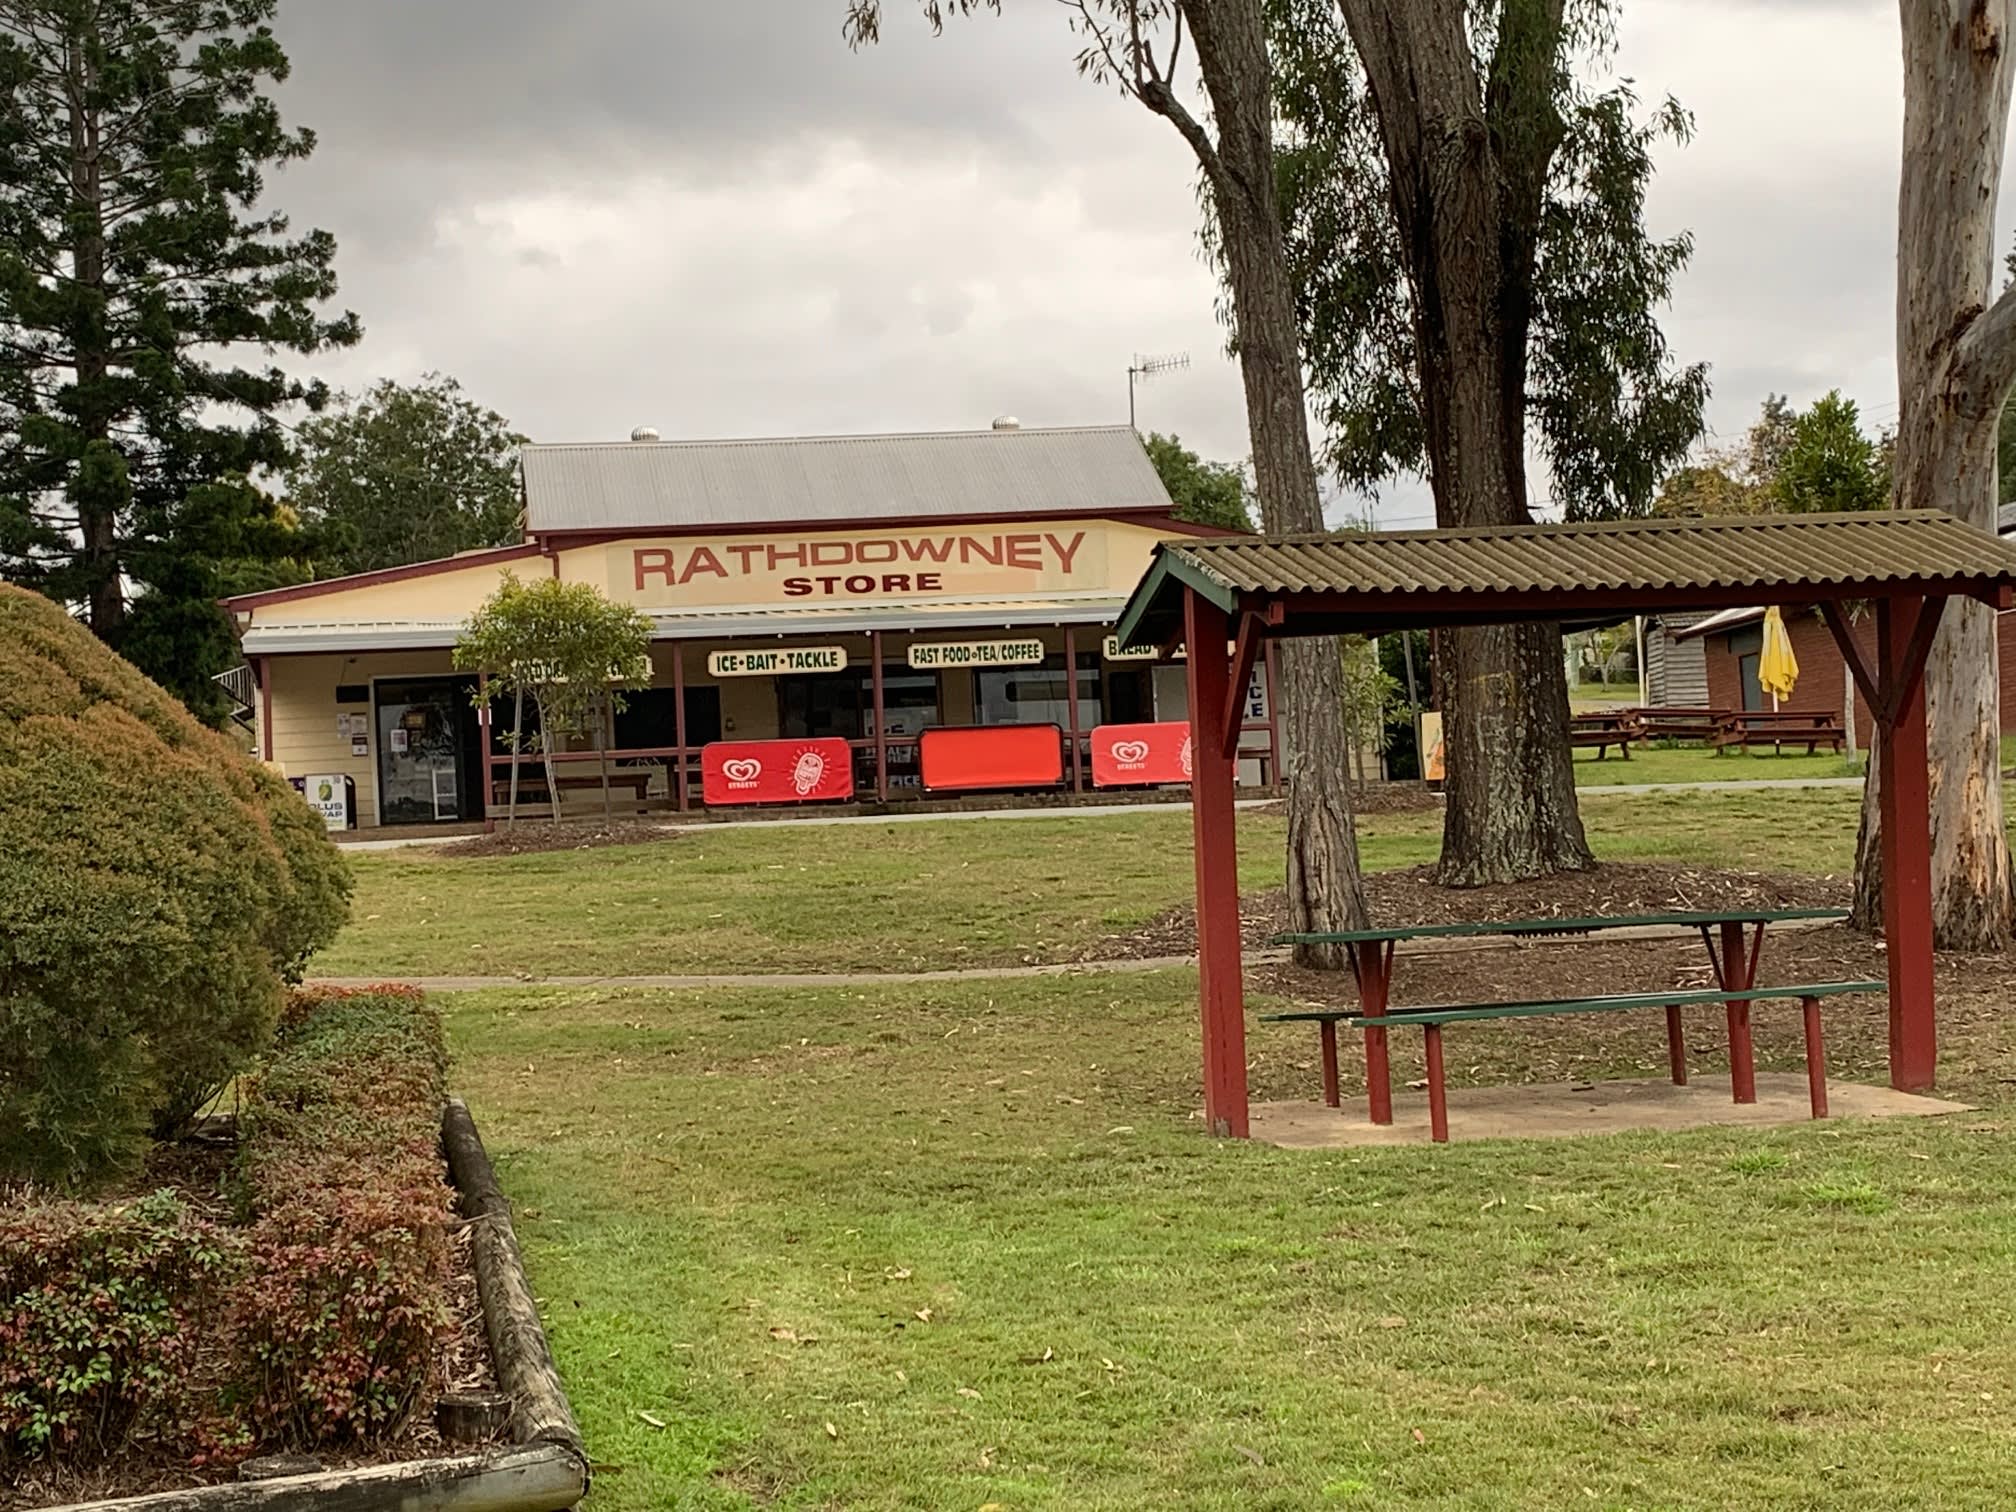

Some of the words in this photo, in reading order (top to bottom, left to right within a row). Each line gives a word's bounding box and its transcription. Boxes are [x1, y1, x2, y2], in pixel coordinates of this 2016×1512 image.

[633, 531, 1086, 591] RATHDOWNEY
[782, 572, 943, 597] STORE
[716, 655, 738, 673] ICE
[746, 653, 778, 671] BAIT
[786, 651, 838, 669] TACKLE
[913, 647, 939, 664] FAST
[942, 645, 970, 662] FOOD
